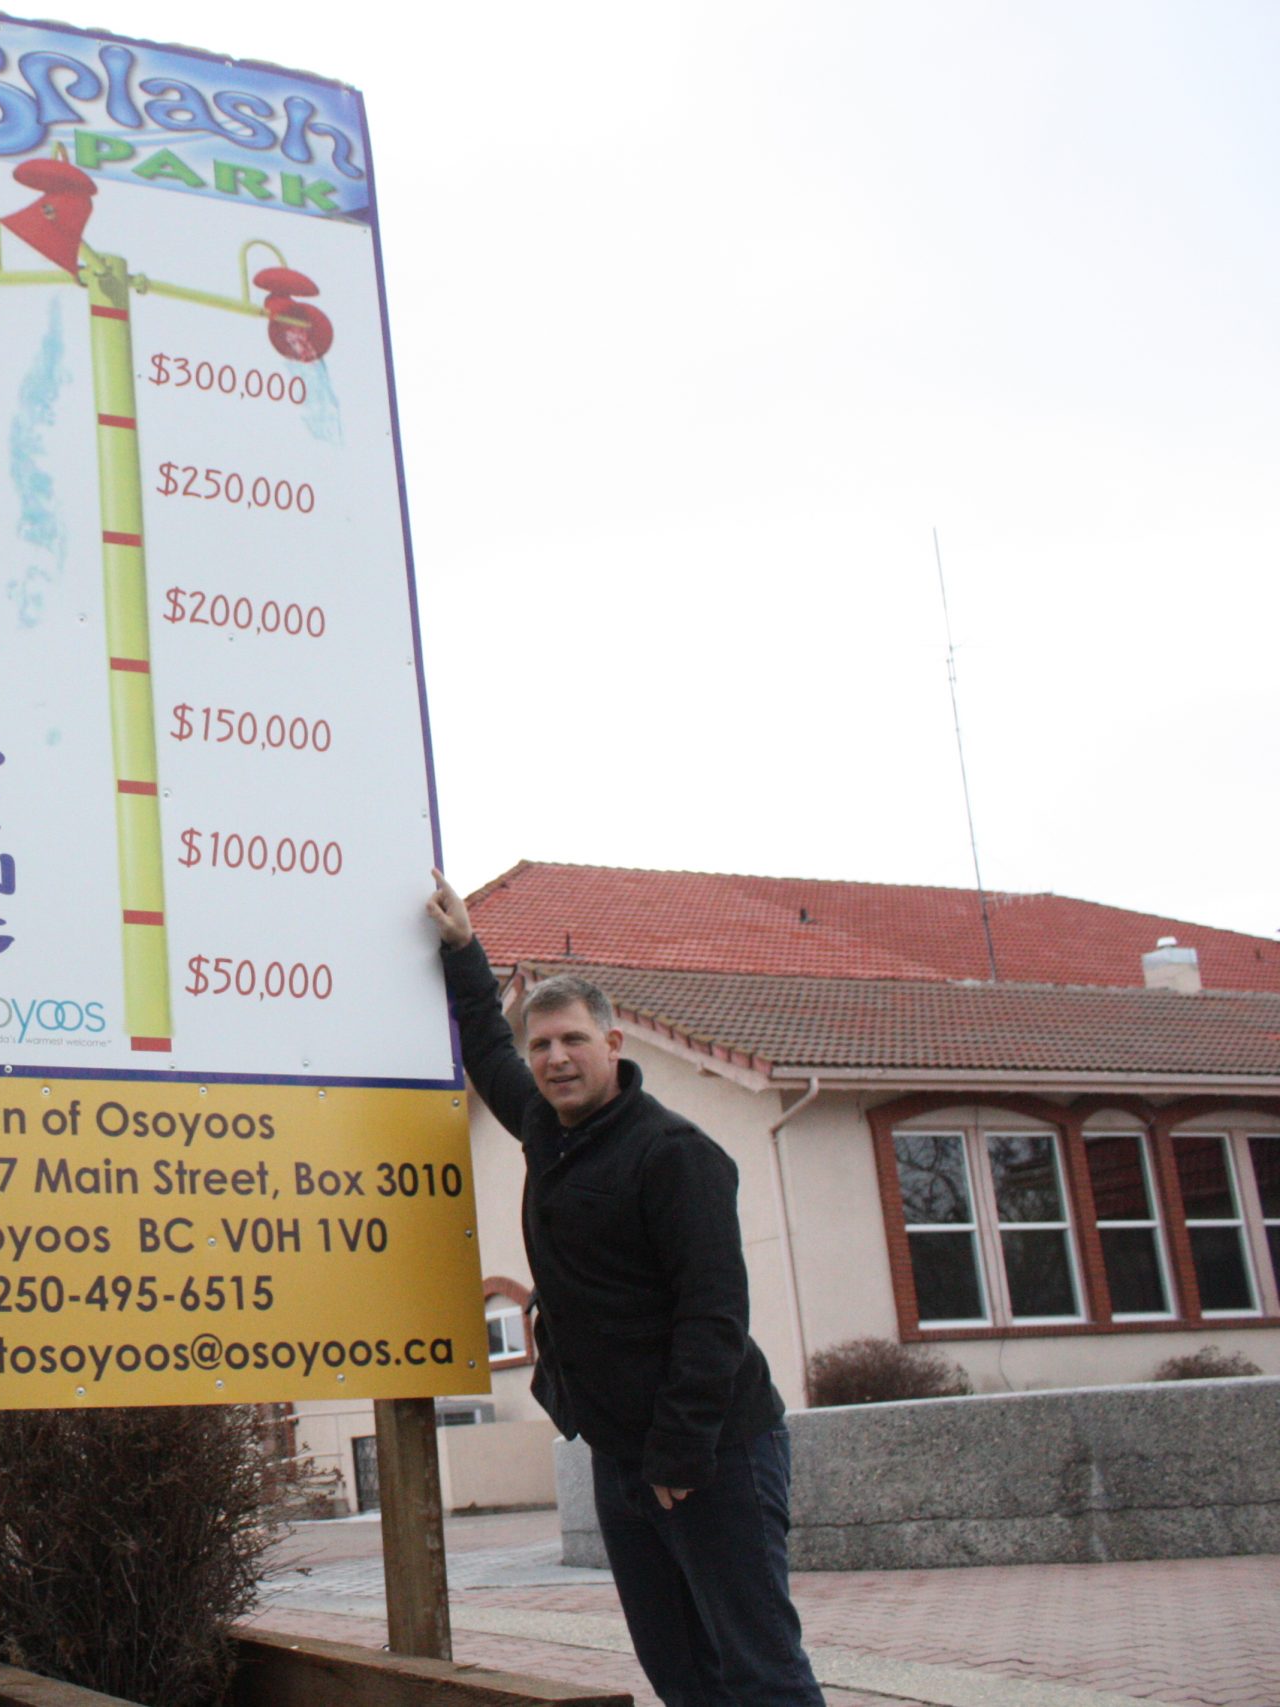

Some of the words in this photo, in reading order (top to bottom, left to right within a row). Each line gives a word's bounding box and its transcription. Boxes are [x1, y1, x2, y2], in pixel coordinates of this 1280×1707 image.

[74, 128, 341, 213] PARK
[148, 352, 307, 405] $300,000
[156, 461, 315, 514] $250,000
[163, 586, 326, 637] $200,000
[170, 703, 332, 752] $150,000
[178, 827, 343, 875] $100,000
[185, 954, 333, 1001] $50,000
[41, 1100, 81, 1136] of
[96, 1100, 276, 1147] Osoyoos
[34, 1157, 138, 1194] Main
[153, 1159, 279, 1200] Street,
[294, 1161, 365, 1196] Box
[376, 1162, 463, 1197] 3010
[139, 1217, 195, 1253] BC
[220, 1217, 301, 1253] V0H
[317, 1217, 388, 1253] 1V0
